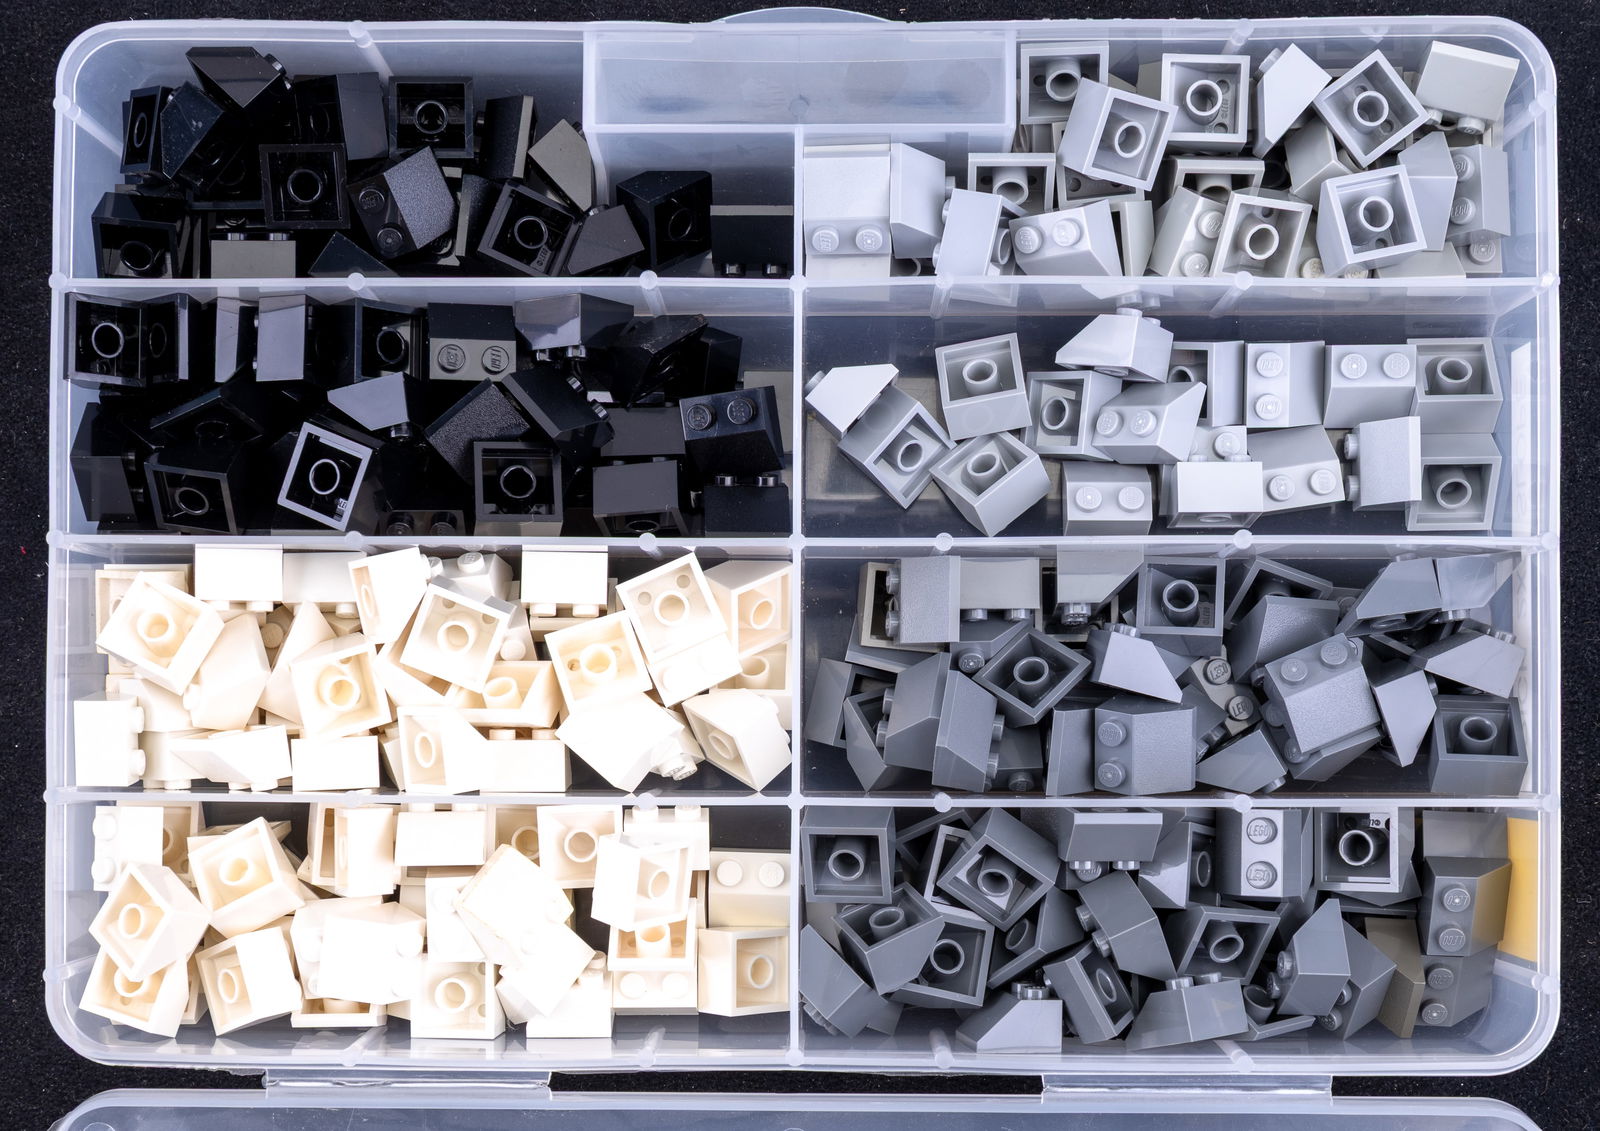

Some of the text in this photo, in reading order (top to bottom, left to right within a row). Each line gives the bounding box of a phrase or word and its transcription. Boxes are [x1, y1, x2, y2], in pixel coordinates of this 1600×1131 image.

[490, 348, 502, 370] LEGO
[1210, 662, 1229, 681] LEGO
[1249, 824, 1269, 837] LEGO
[1249, 868, 1269, 882] LEGO
[1442, 935, 1464, 946] LEGO
